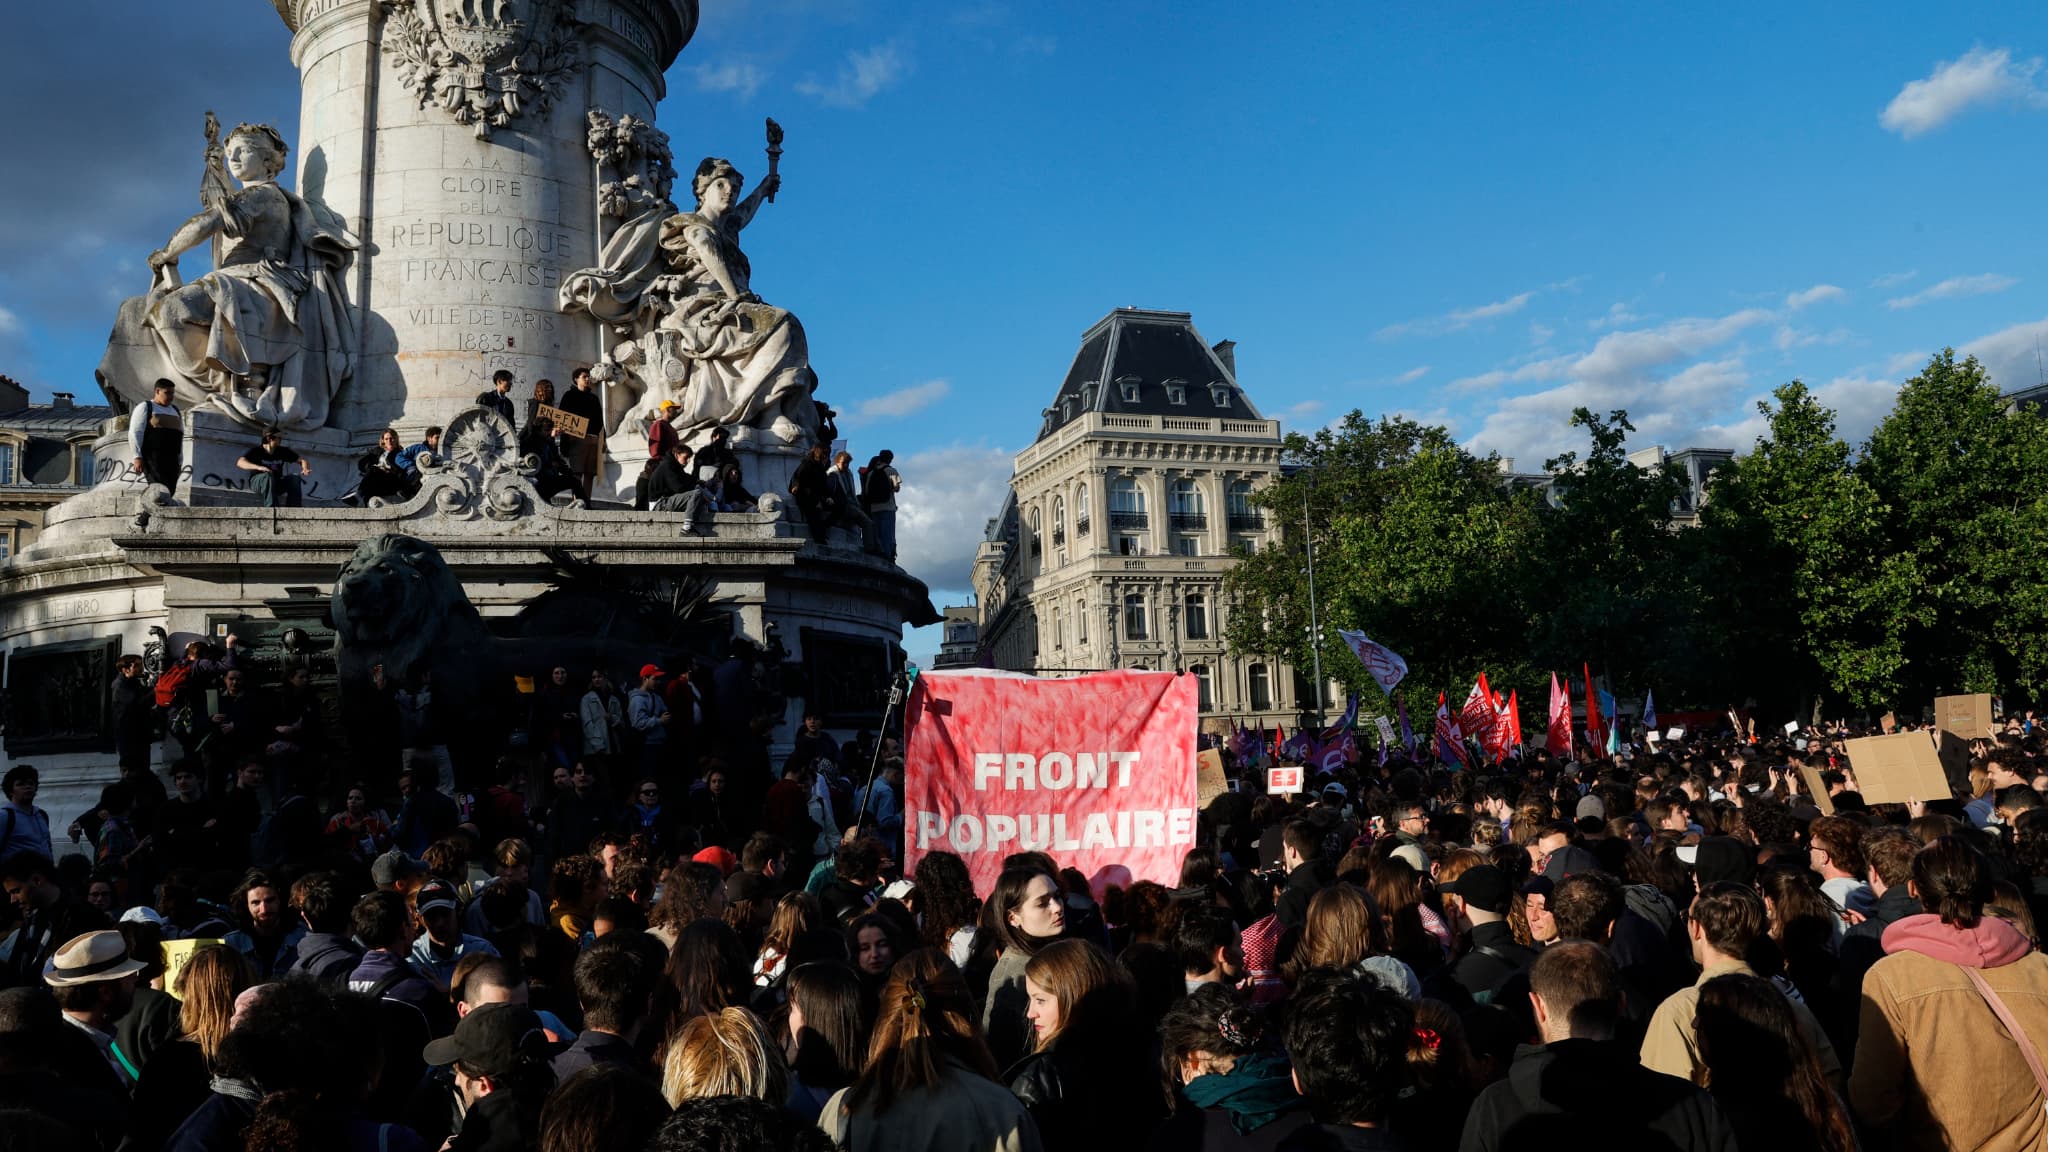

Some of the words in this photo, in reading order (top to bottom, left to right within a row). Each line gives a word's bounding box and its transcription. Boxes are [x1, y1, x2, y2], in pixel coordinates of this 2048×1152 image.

[481, 156, 503, 169] LA
[441, 176, 522, 197] GLOIRE
[460, 201, 479, 214] DE
[487, 203, 503, 215] LA
[391, 218, 571, 258] RÉPUBLIQUE
[406, 260, 557, 289] FRANÇAISE
[409, 309, 460, 326] VILLE
[469, 309, 497, 326] DE
[502, 311, 554, 332] PARIS
[459, 333, 505, 352] 1883
[73, 598, 100, 616] 1880
[974, 751, 1141, 791] FRONT
[916, 807, 1194, 852] POPULAIRE
